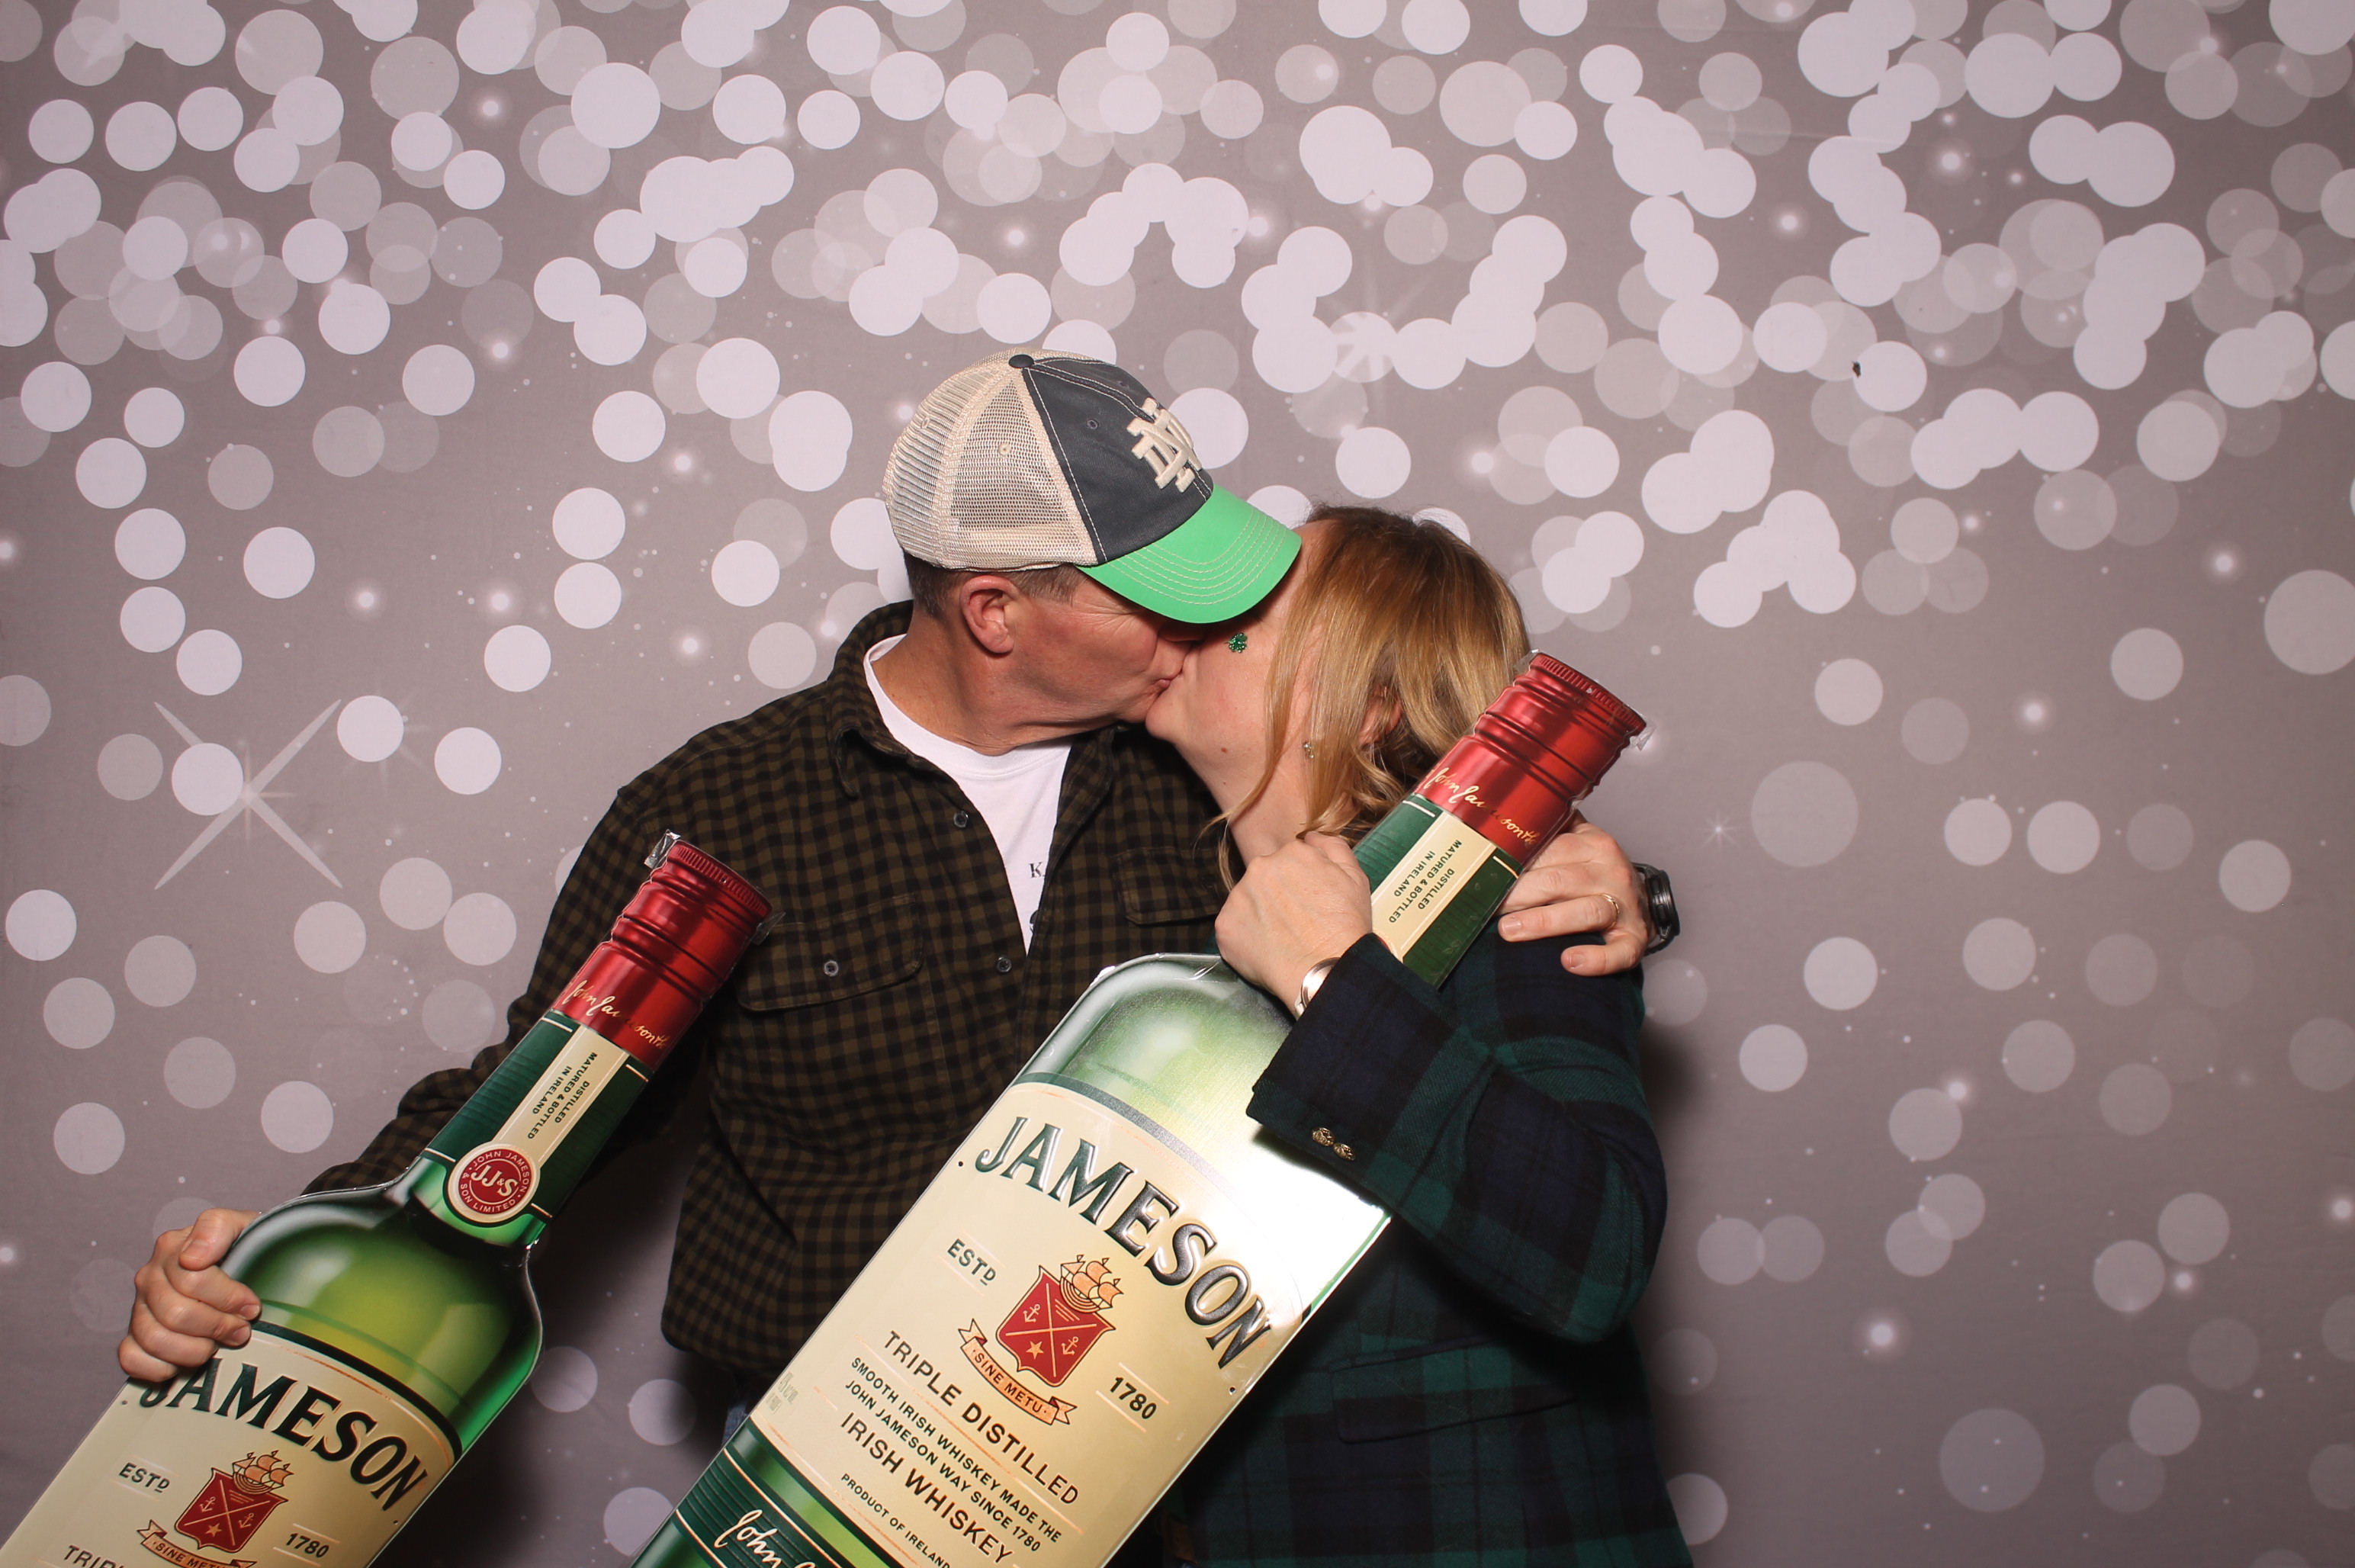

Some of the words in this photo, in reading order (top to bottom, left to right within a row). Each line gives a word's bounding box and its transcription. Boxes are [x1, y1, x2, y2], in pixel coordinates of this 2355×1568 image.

[1030, 862, 1046, 879] K
[1425, 850, 1436, 862] IN
[1427, 840, 1463, 879] MATURED
[1393, 861, 1427, 897] IRELAND
[1418, 868, 1455, 910] DISTILLED
[1419, 878, 1428, 886] &
[1389, 885, 1423, 924] BOTTLED
[561, 1065, 573, 1076] IN
[564, 1052, 598, 1093] MATURED
[532, 1077, 564, 1114] IRELAND
[554, 1081, 590, 1123] DISTILLED
[528, 1101, 560, 1139] BOTTLED
[471, 1165, 519, 1197] JJ&S
[473, 1151, 502, 1167] JOHN
[506, 1152, 530, 1193] JAMESON
[460, 1183, 473, 1203] SON
[473, 1199, 516, 1213] LIMITED
[975, 1116, 1271, 1370] JAMESON
[974, 1352, 1007, 1384] SINE
[1004, 1383, 1043, 1413] METU
[1110, 1376, 1157, 1420] 1780
[884, 1330, 963, 1406] TRIPLE
[962, 1403, 1079, 1505] DISTILLED
[845, 1380, 877, 1410] JOHN
[875, 1409, 940, 1466] JAMESON
[939, 1462, 972, 1492] WAY
[970, 1490, 1014, 1529] SINCE
[1012, 1525, 1042, 1553] 1780
[851, 1358, 900, 1403] SMOOTH
[898, 1401, 937, 1437] IRISH
[937, 1434, 1001, 1492] WHISKEY
[999, 1489, 1039, 1524] MADE
[1038, 1519, 1062, 1544] THE
[840, 1412, 905, 1474] IRISH
[904, 1467, 1014, 1564] WHISKEY
[714, 1509, 782, 1568] John
[841, 1473, 890, 1518] PRODUCT
[889, 1516, 907, 1532] OF
[904, 1530, 951, 1568] IRELAND
[64, 1544, 124, 1568] TRIP
[156, 1542, 186, 1563] SINE
[284, 1532, 330, 1559] 1780
